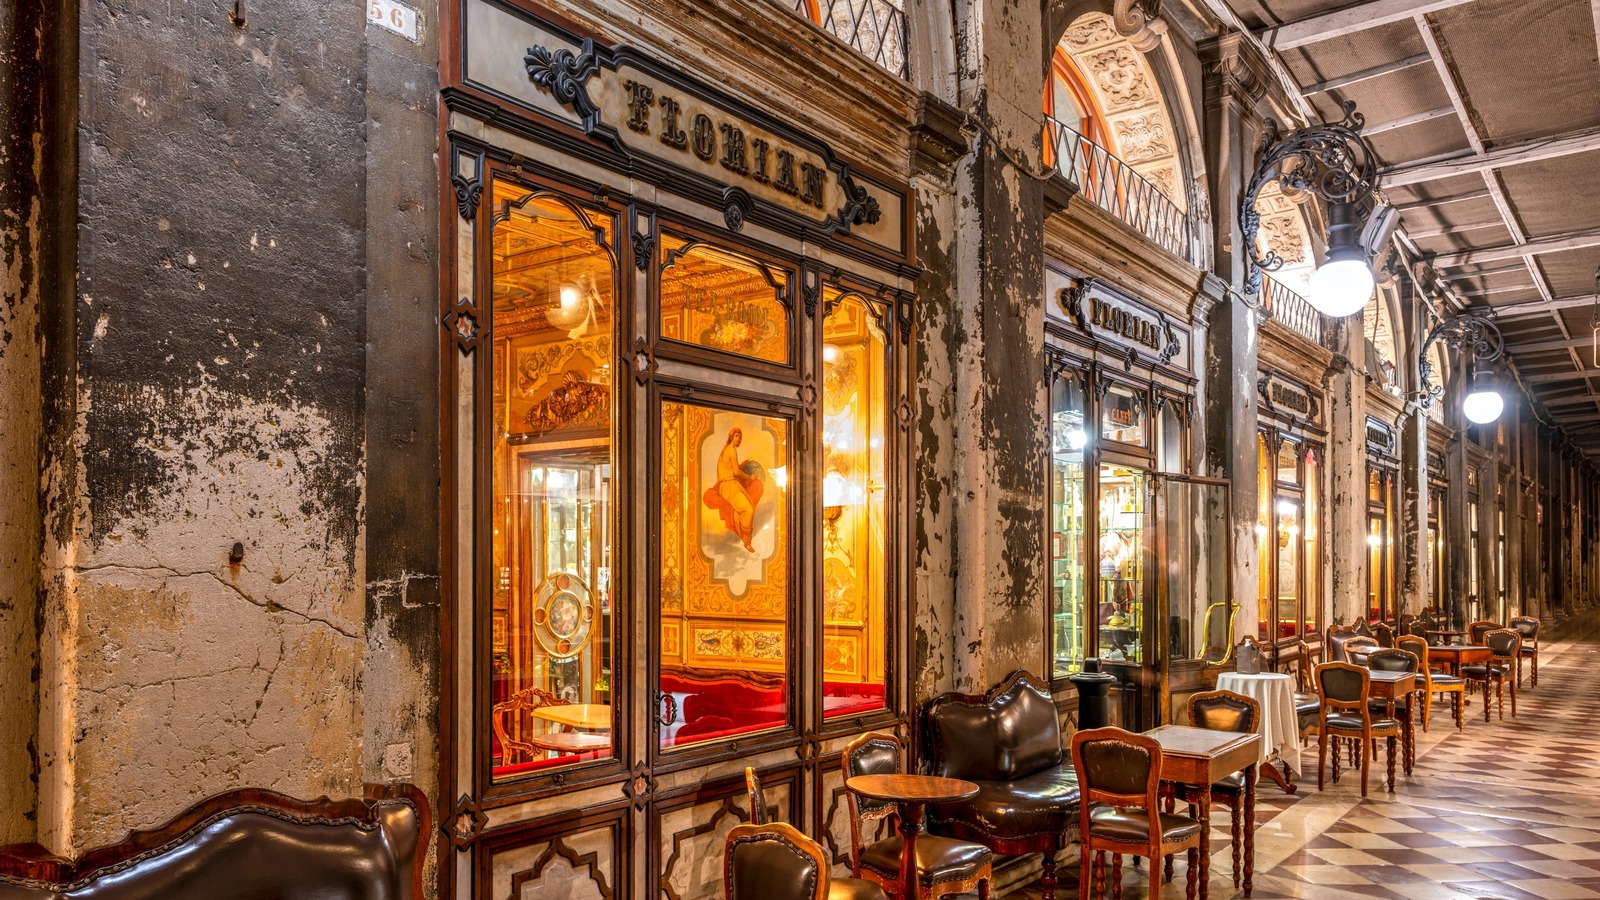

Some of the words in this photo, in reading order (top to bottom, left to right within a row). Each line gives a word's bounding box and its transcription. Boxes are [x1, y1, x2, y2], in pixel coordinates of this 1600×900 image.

[370, 0, 403, 28] 56
[623, 78, 827, 210] FLORIAN
[725, 296, 769, 331] ROOM
[1089, 297, 1162, 351] FLORIAN
